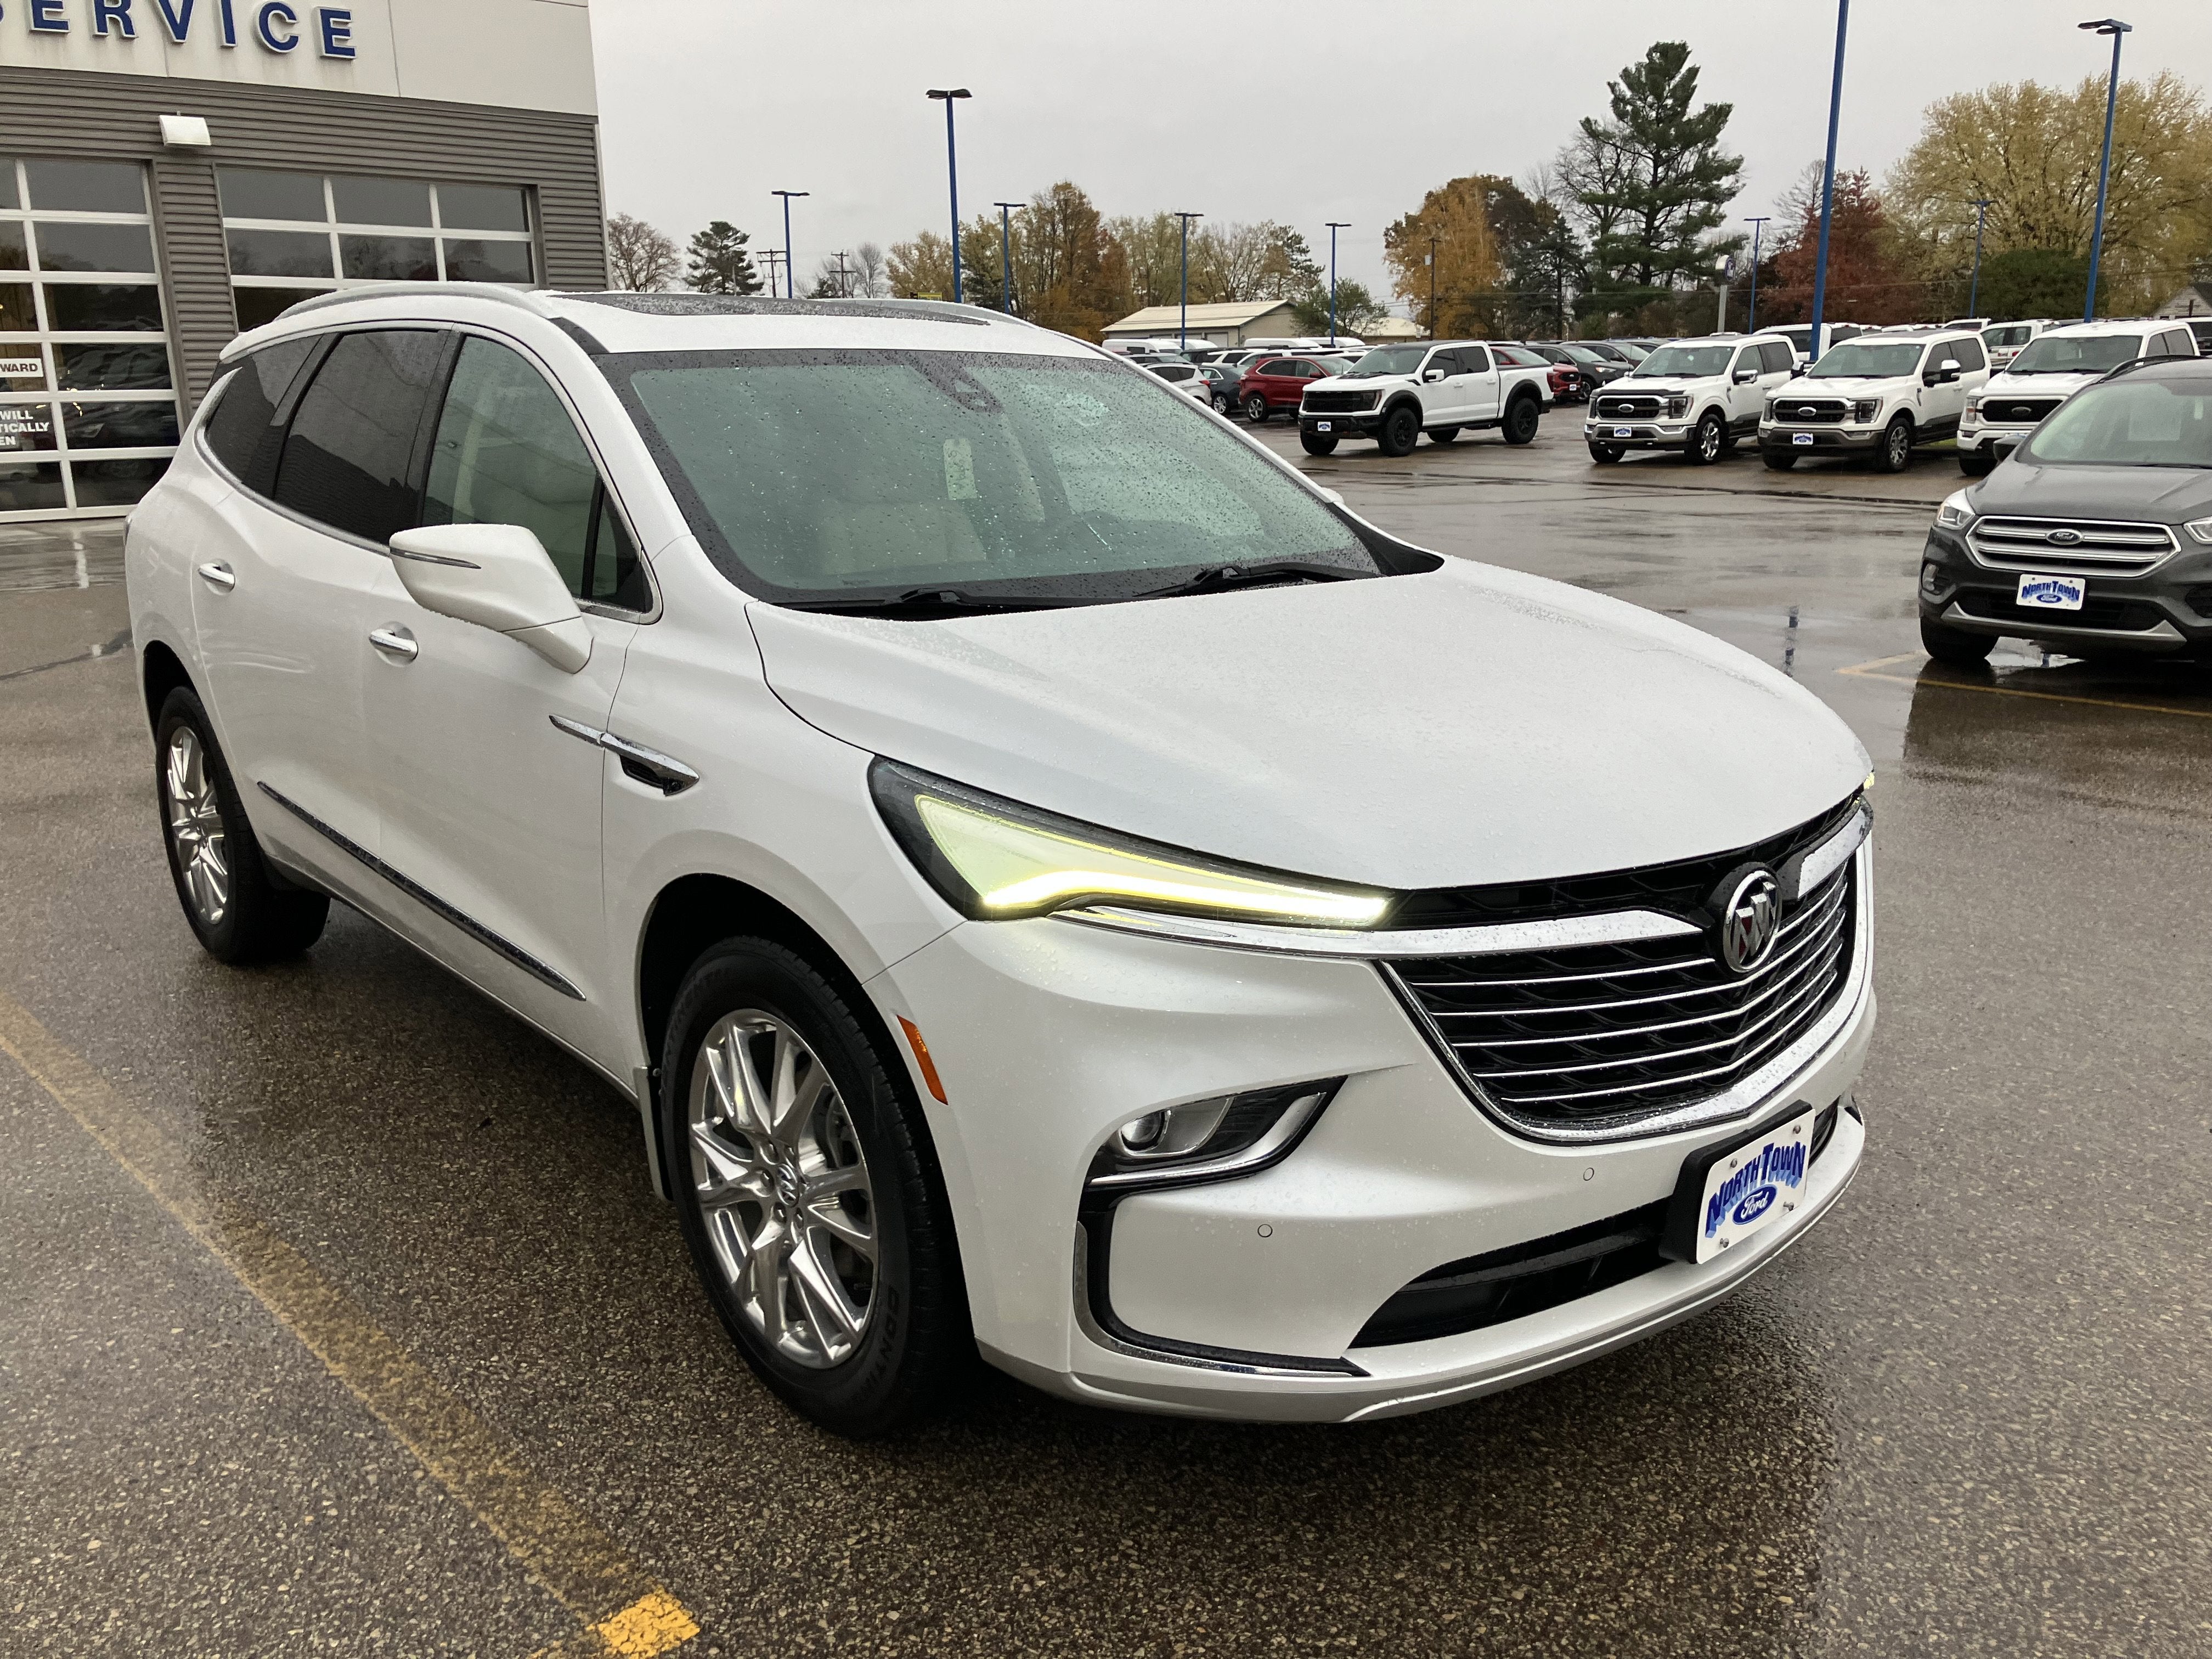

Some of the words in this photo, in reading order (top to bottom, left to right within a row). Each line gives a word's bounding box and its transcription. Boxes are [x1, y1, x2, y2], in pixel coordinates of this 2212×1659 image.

[0, 0, 357, 59] ERVICE
[0, 410, 33, 420] WILL
[1740, 1190, 1769, 1219] Ford
